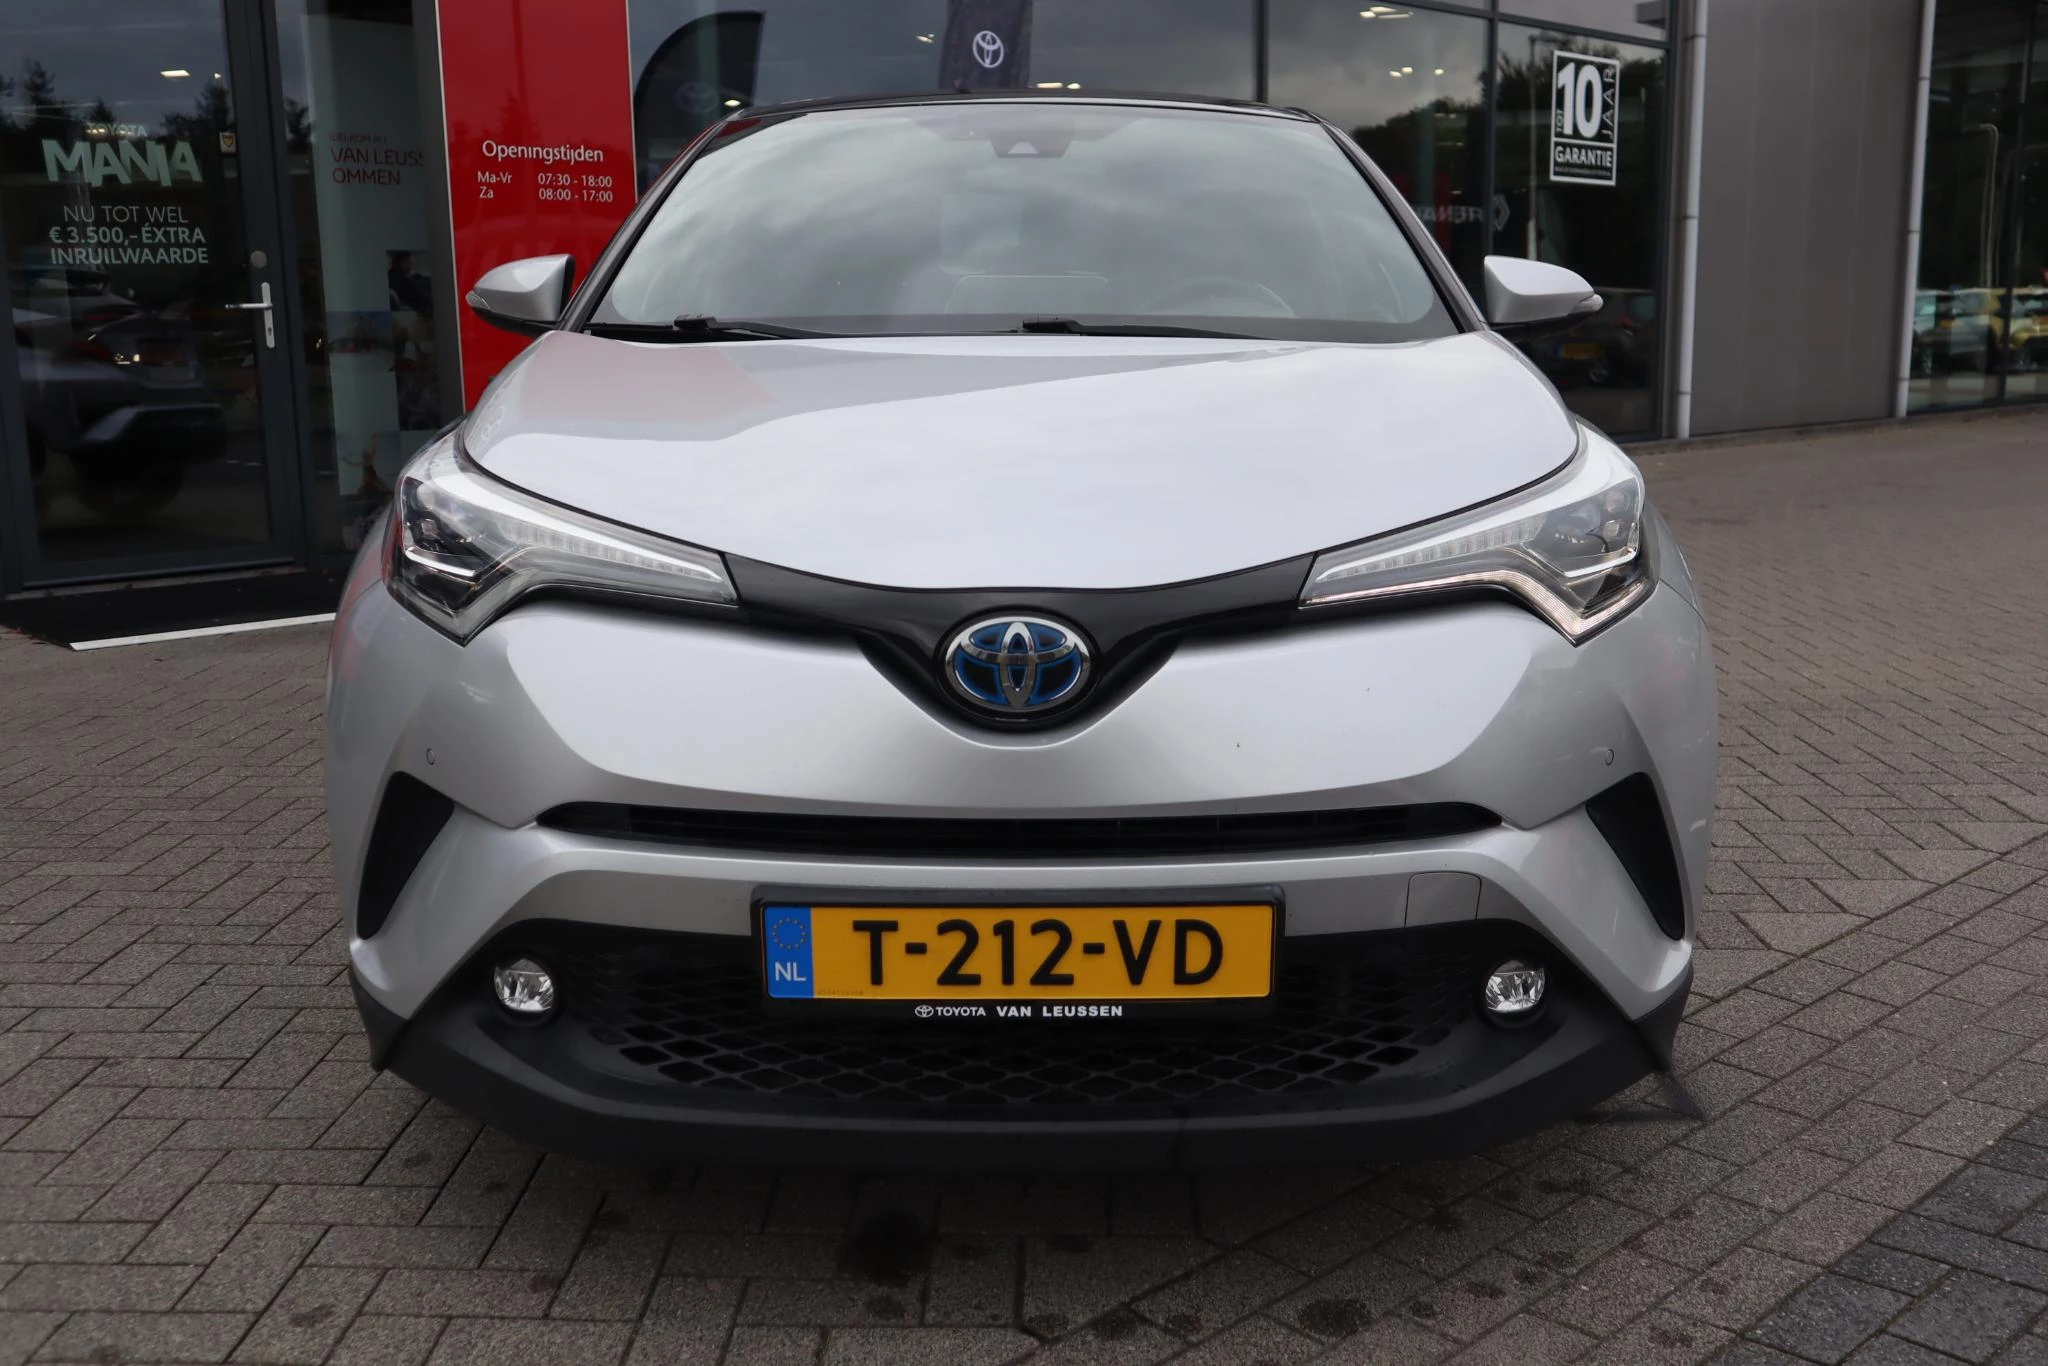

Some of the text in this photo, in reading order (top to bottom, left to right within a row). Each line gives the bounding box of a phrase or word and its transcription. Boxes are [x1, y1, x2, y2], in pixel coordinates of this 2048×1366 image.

[1557, 61, 1603, 139] 10
[1601, 64, 1616, 140] JAAR
[86, 121, 148, 137] TOYOTA
[330, 146, 368, 164] VAN
[482, 139, 604, 166] Openingstijden
[1555, 146, 1613, 168] GARANTIE
[41, 137, 204, 188] MANIA
[332, 167, 401, 185] OMMEN
[477, 171, 512, 184] Ma-Vr
[538, 172, 570, 187] 07:30
[582, 174, 613, 188] 18:00
[479, 186, 494, 199] Za
[538, 188, 571, 201] 08:00
[583, 189, 613, 203] 17:00
[63, 205, 189, 223] NU TOT WEL
[48, 226, 62, 244] €
[141, 222, 207, 244] ÉXTRA
[50, 247, 209, 265] INRUILWAARDE
[852, 918, 1224, 987] T-212-VD
[774, 961, 807, 982] NL
[935, 1005, 1123, 1017] TOYOTA VAN LEUSSEN
